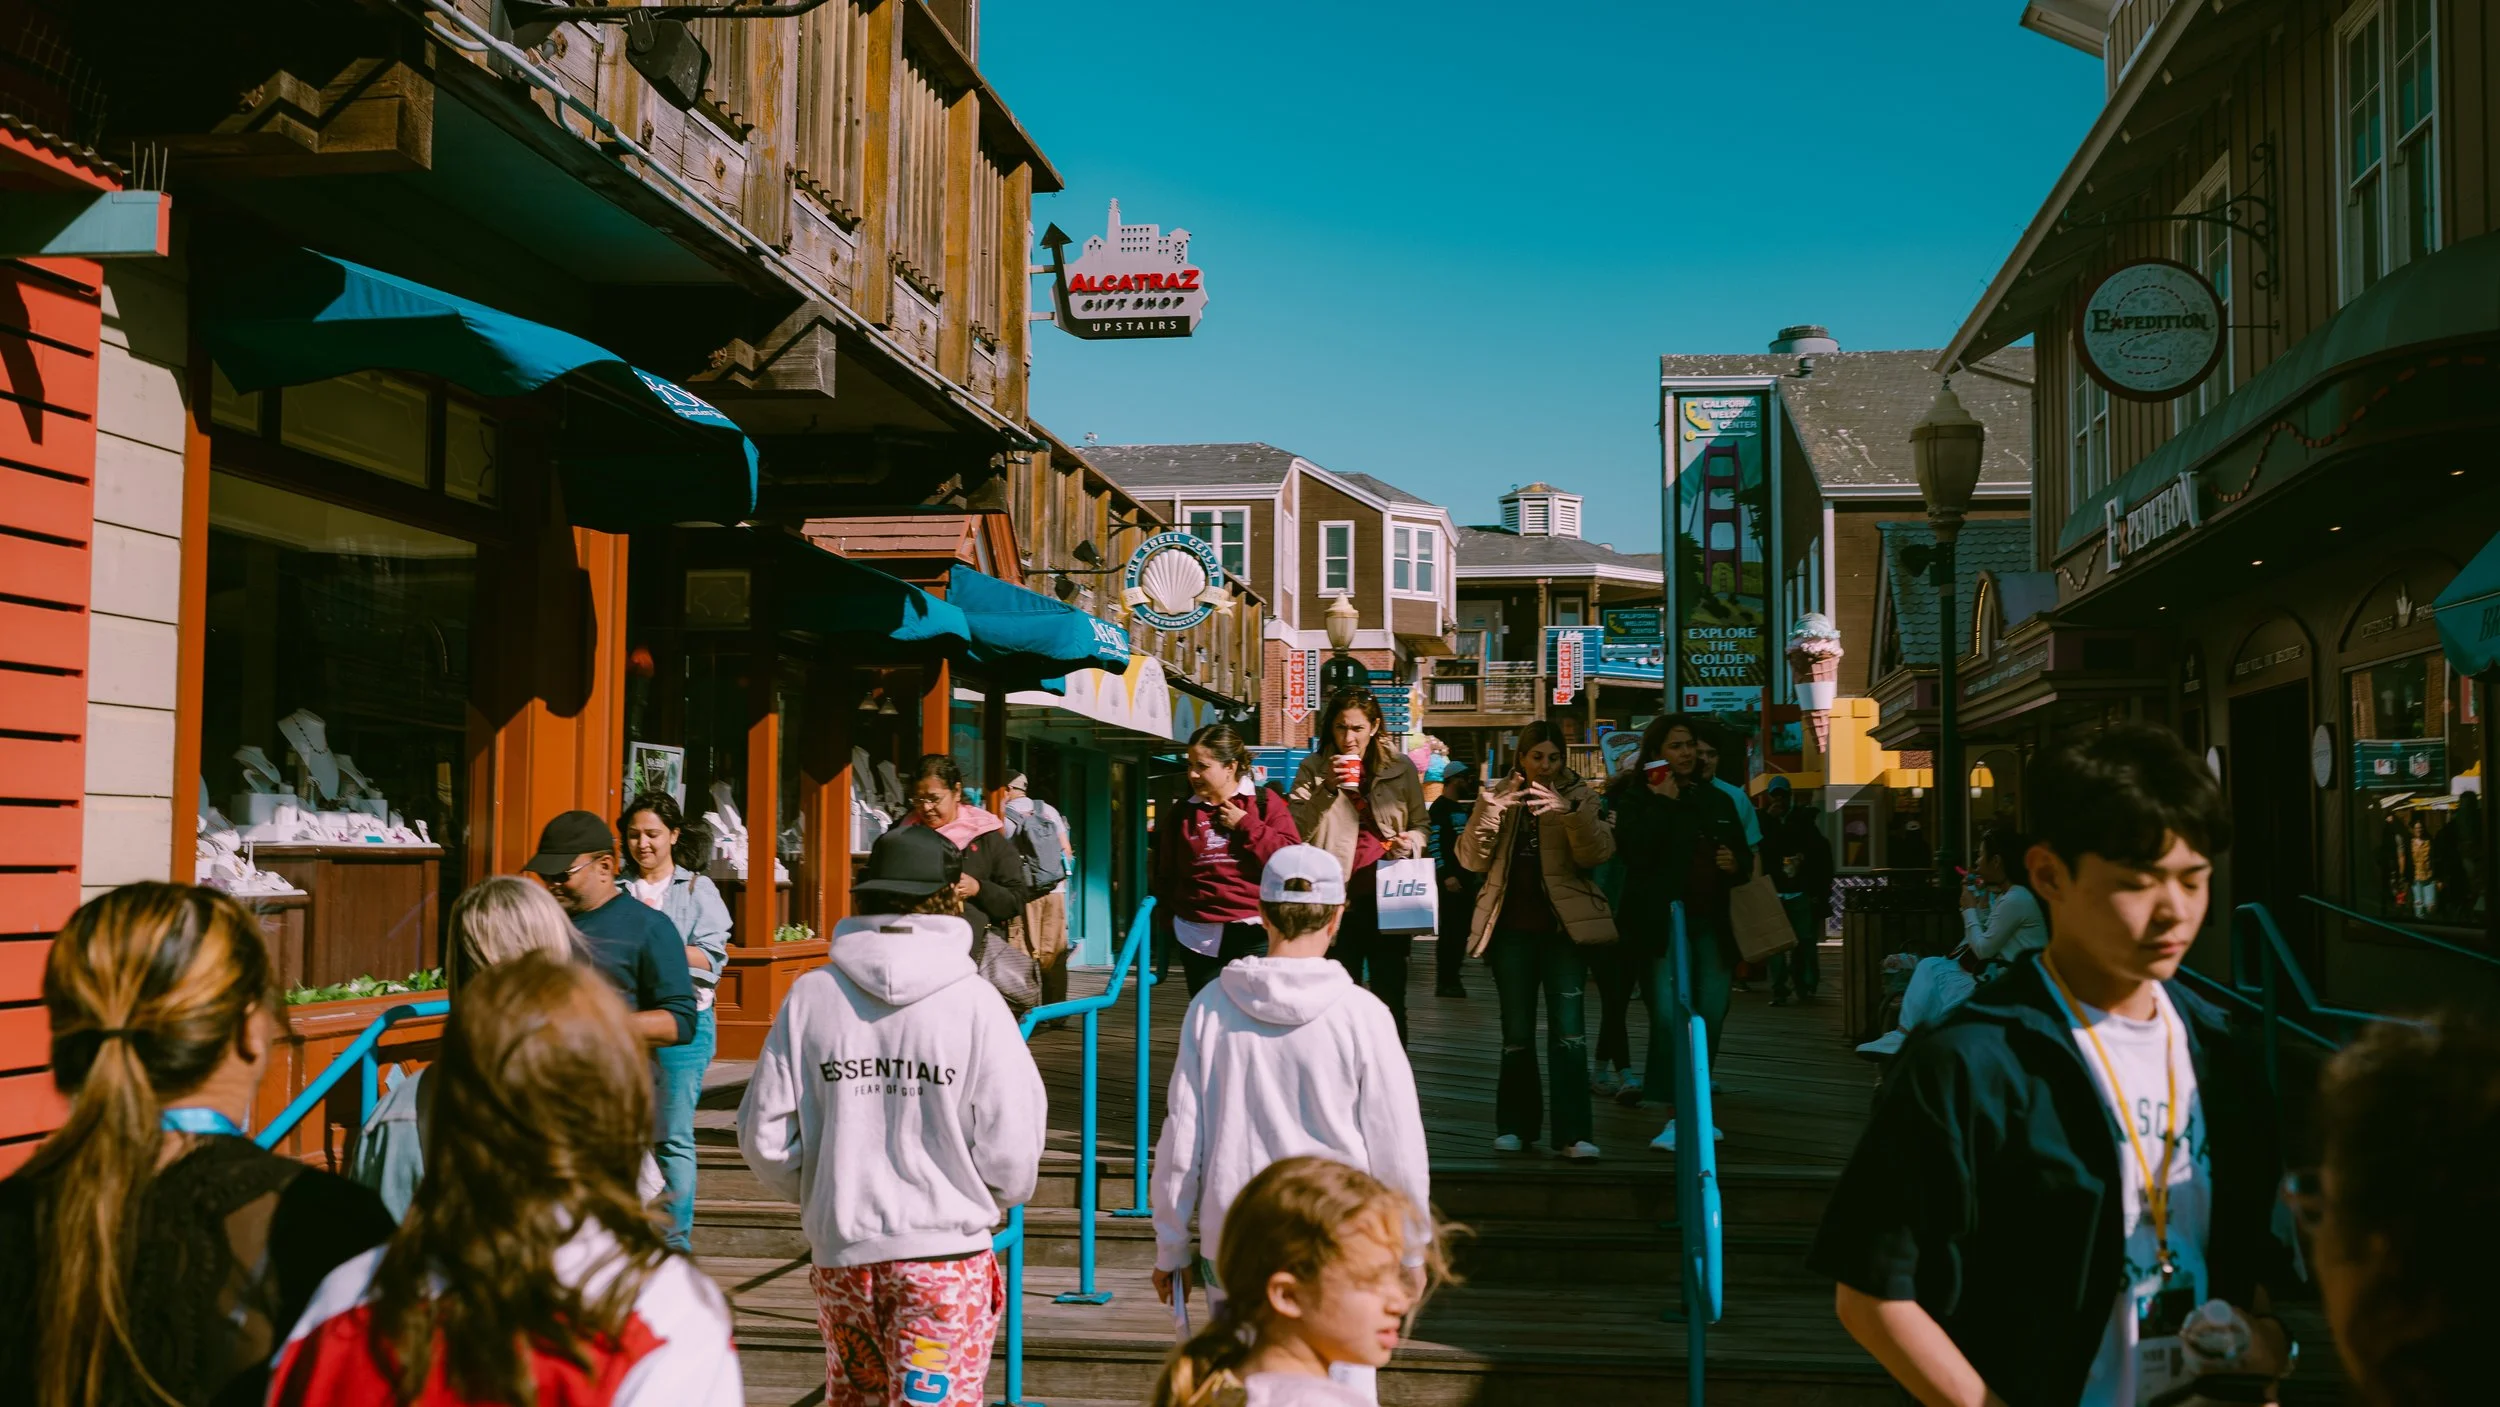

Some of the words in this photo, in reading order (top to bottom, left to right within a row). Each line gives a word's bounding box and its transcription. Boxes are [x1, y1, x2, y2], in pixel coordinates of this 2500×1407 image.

[1069, 269, 1199, 293] ALCATRAZ
[1082, 297, 1127, 312] GIFT
[1132, 296, 1185, 311] SHOP
[1092, 320, 1177, 332] UPSTAIRS
[1702, 399, 1757, 409] CALIFORNIA
[1709, 410, 1757, 419] WELCOME
[1719, 420, 1757, 430] CENTER
[1126, 557, 1142, 579] THE
[1142, 534, 1181, 553] SHELL
[1188, 538, 1220, 578] CELLAR
[1688, 627, 1758, 639] EXPLORE
[1708, 640, 1738, 652] THE
[1691, 653, 1756, 665] GOLDEN
[1700, 666, 1747, 678] STATE
[1383, 878, 1427, 898] Lids
[819, 1058, 956, 1086] ESSENTIALS
[854, 1084, 880, 1097] FEAR
[886, 1084, 898, 1095] OF
[901, 1087, 924, 1097] GOD
